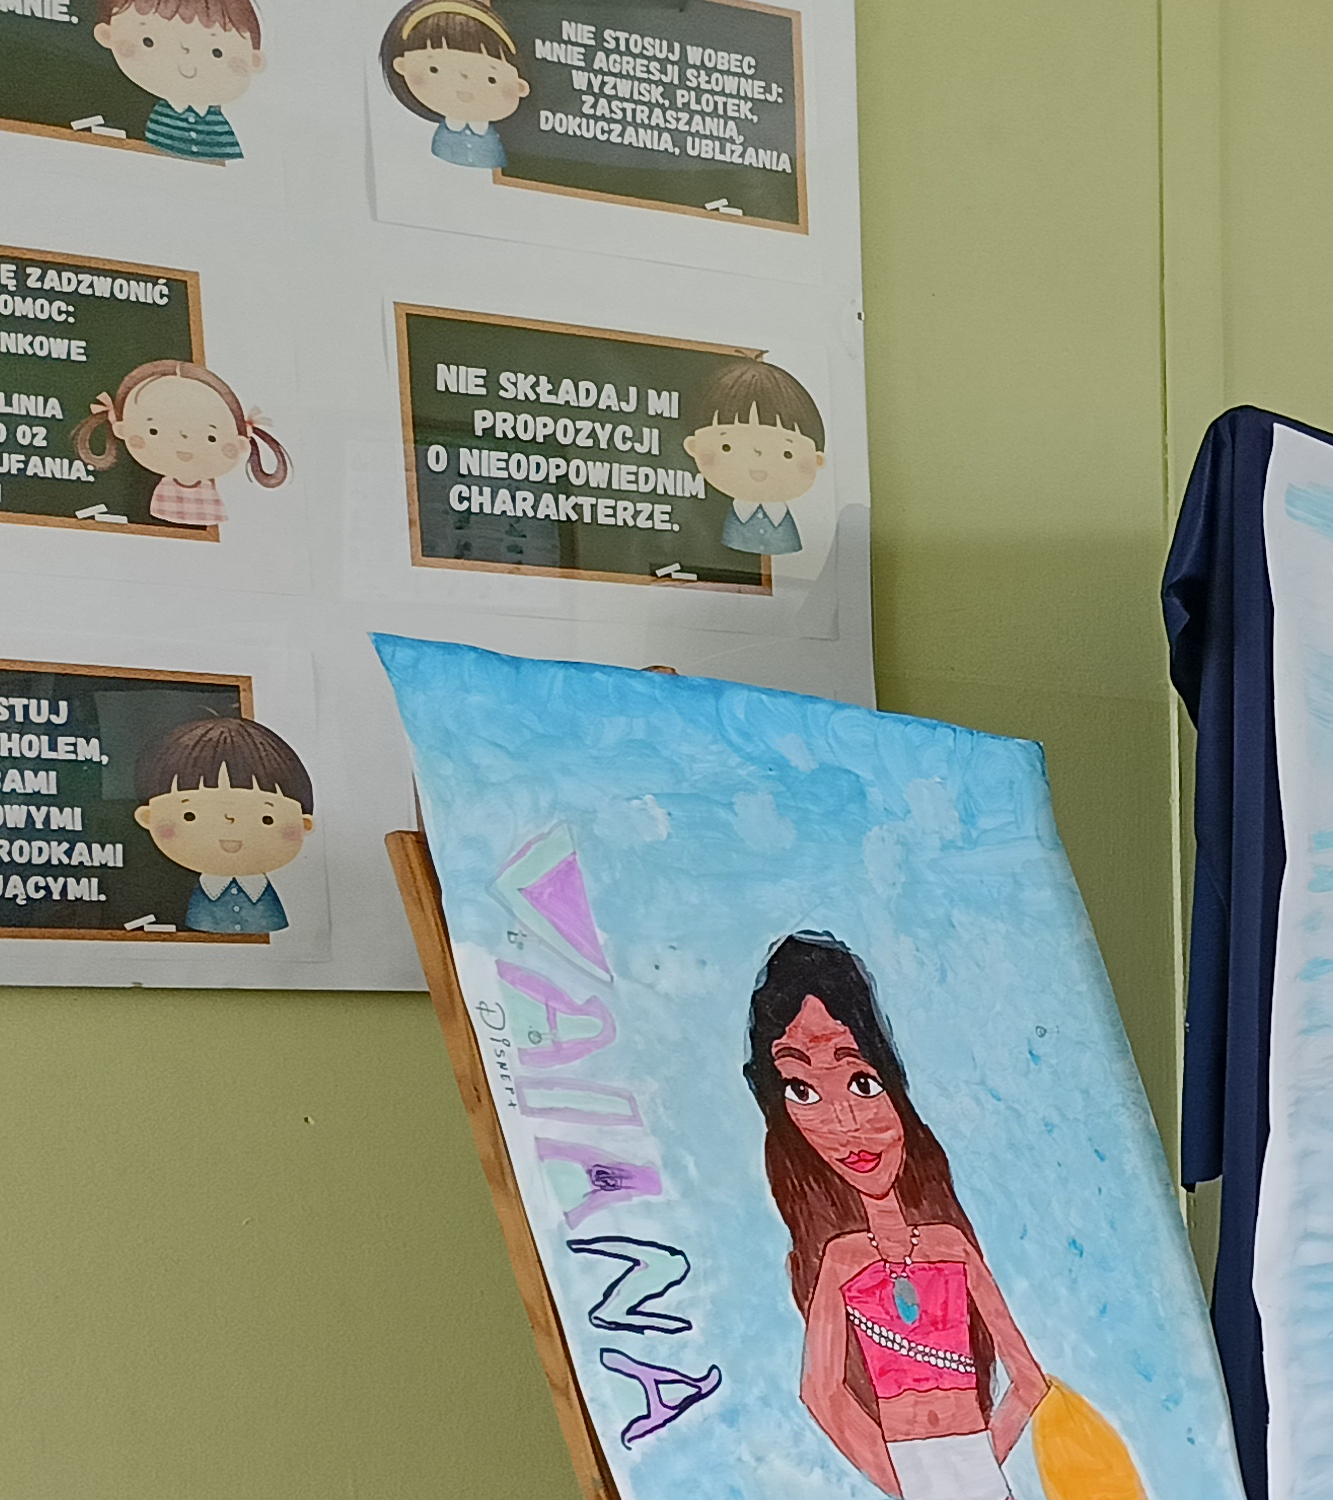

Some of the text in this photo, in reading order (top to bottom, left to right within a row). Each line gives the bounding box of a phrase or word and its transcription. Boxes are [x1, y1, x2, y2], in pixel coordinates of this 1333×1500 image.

[534, 38, 783, 103] MNIE AGRESJI SŁOWNEJ:
[562, 20, 756, 75] NIE STOSUJ WOBEC
[572, 70, 758, 123] WYZWISK, PLOTEK,
[540, 110, 792, 173] DOKUCZANIA, UBLIŻANIA
[25, 267, 169, 306] ZADZWONIĆ
[0, 332, 87, 362] NKOWE
[0, 392, 64, 420] LINIA
[436, 364, 680, 419] NIE SKŁADAJ MI
[473, 409, 660, 456] PROPOZYCJI
[427, 445, 706, 499] O NIEODPOWIEDNIM
[449, 484, 681, 533] CHARAKTERZE.
[0, 732, 110, 765] HOLEM,
[0, 769, 58, 795] AMI
[0, 874, 108, 905] ĄCYMI.
